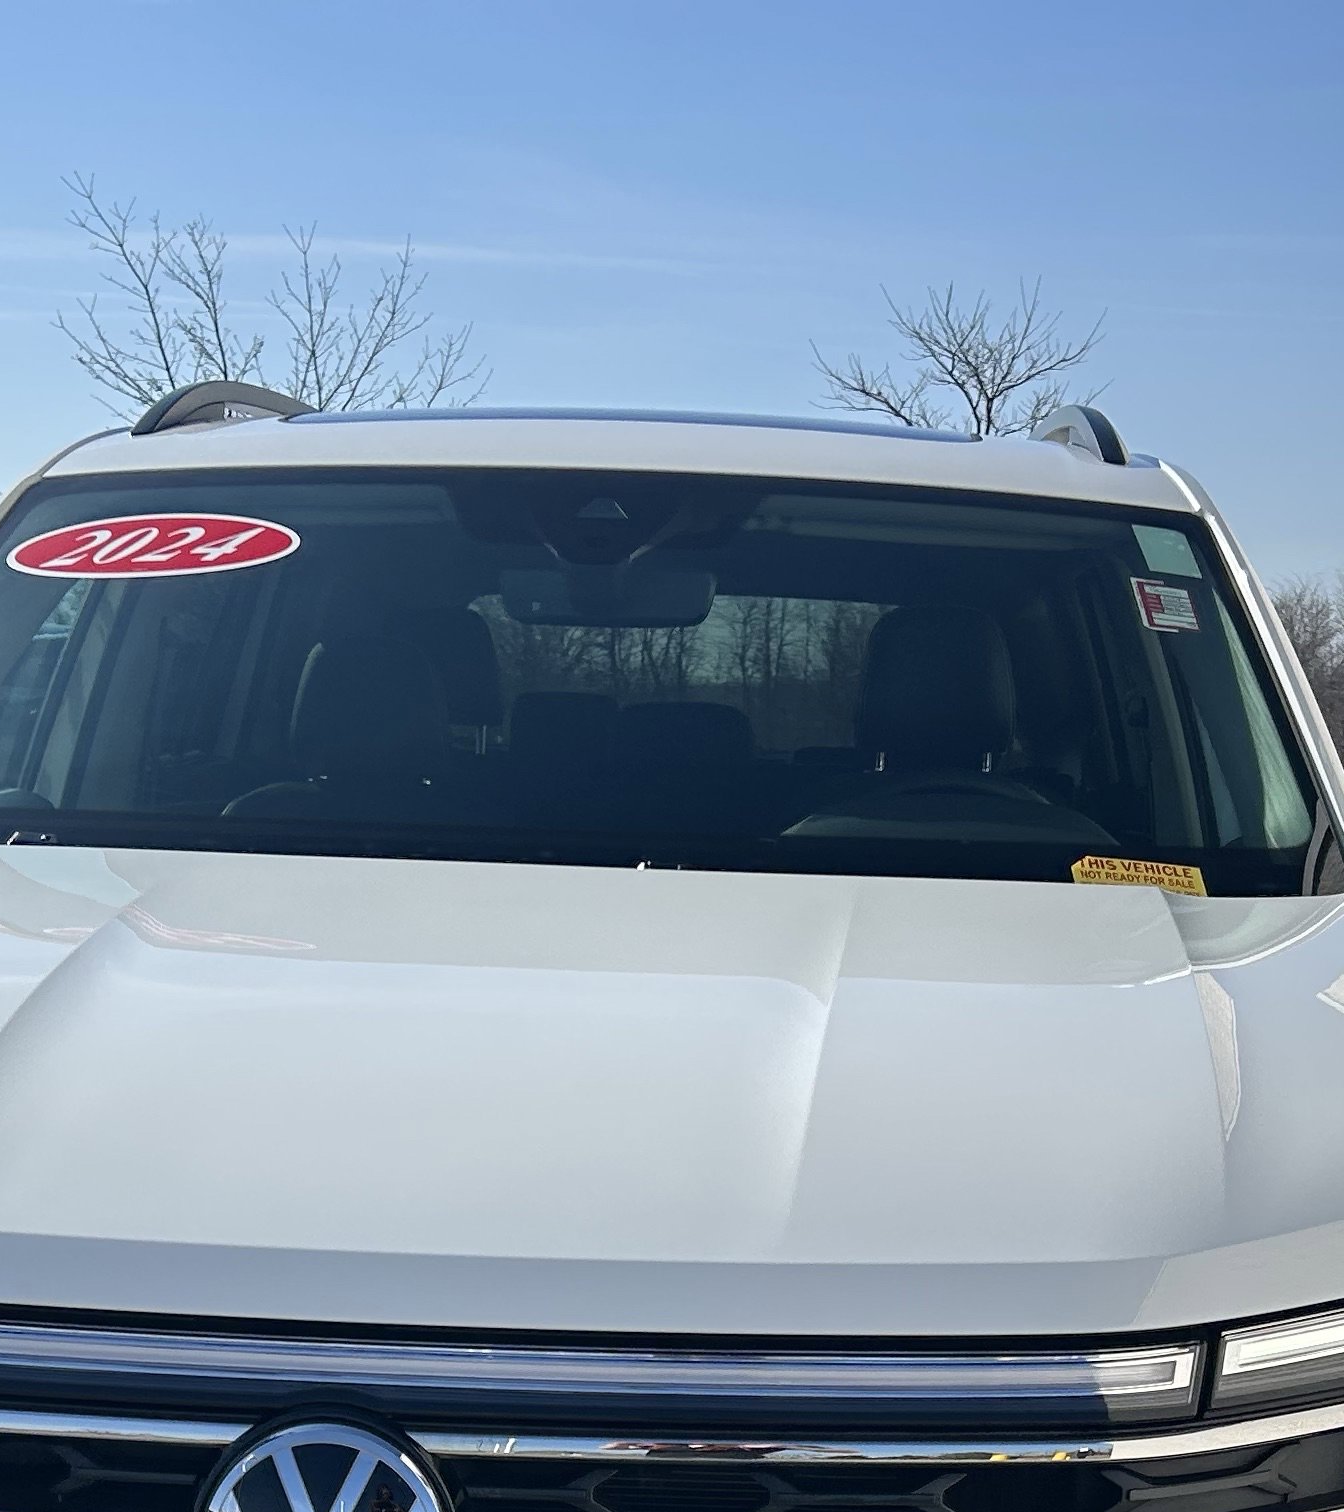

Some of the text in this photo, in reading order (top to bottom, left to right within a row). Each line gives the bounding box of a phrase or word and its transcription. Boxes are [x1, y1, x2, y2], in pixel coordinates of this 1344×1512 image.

[38, 527, 266, 569] 2024
[1079, 858, 1193, 878] THIS VEHICLE
[1080, 870, 1196, 889] NOT READY FOR SALE
